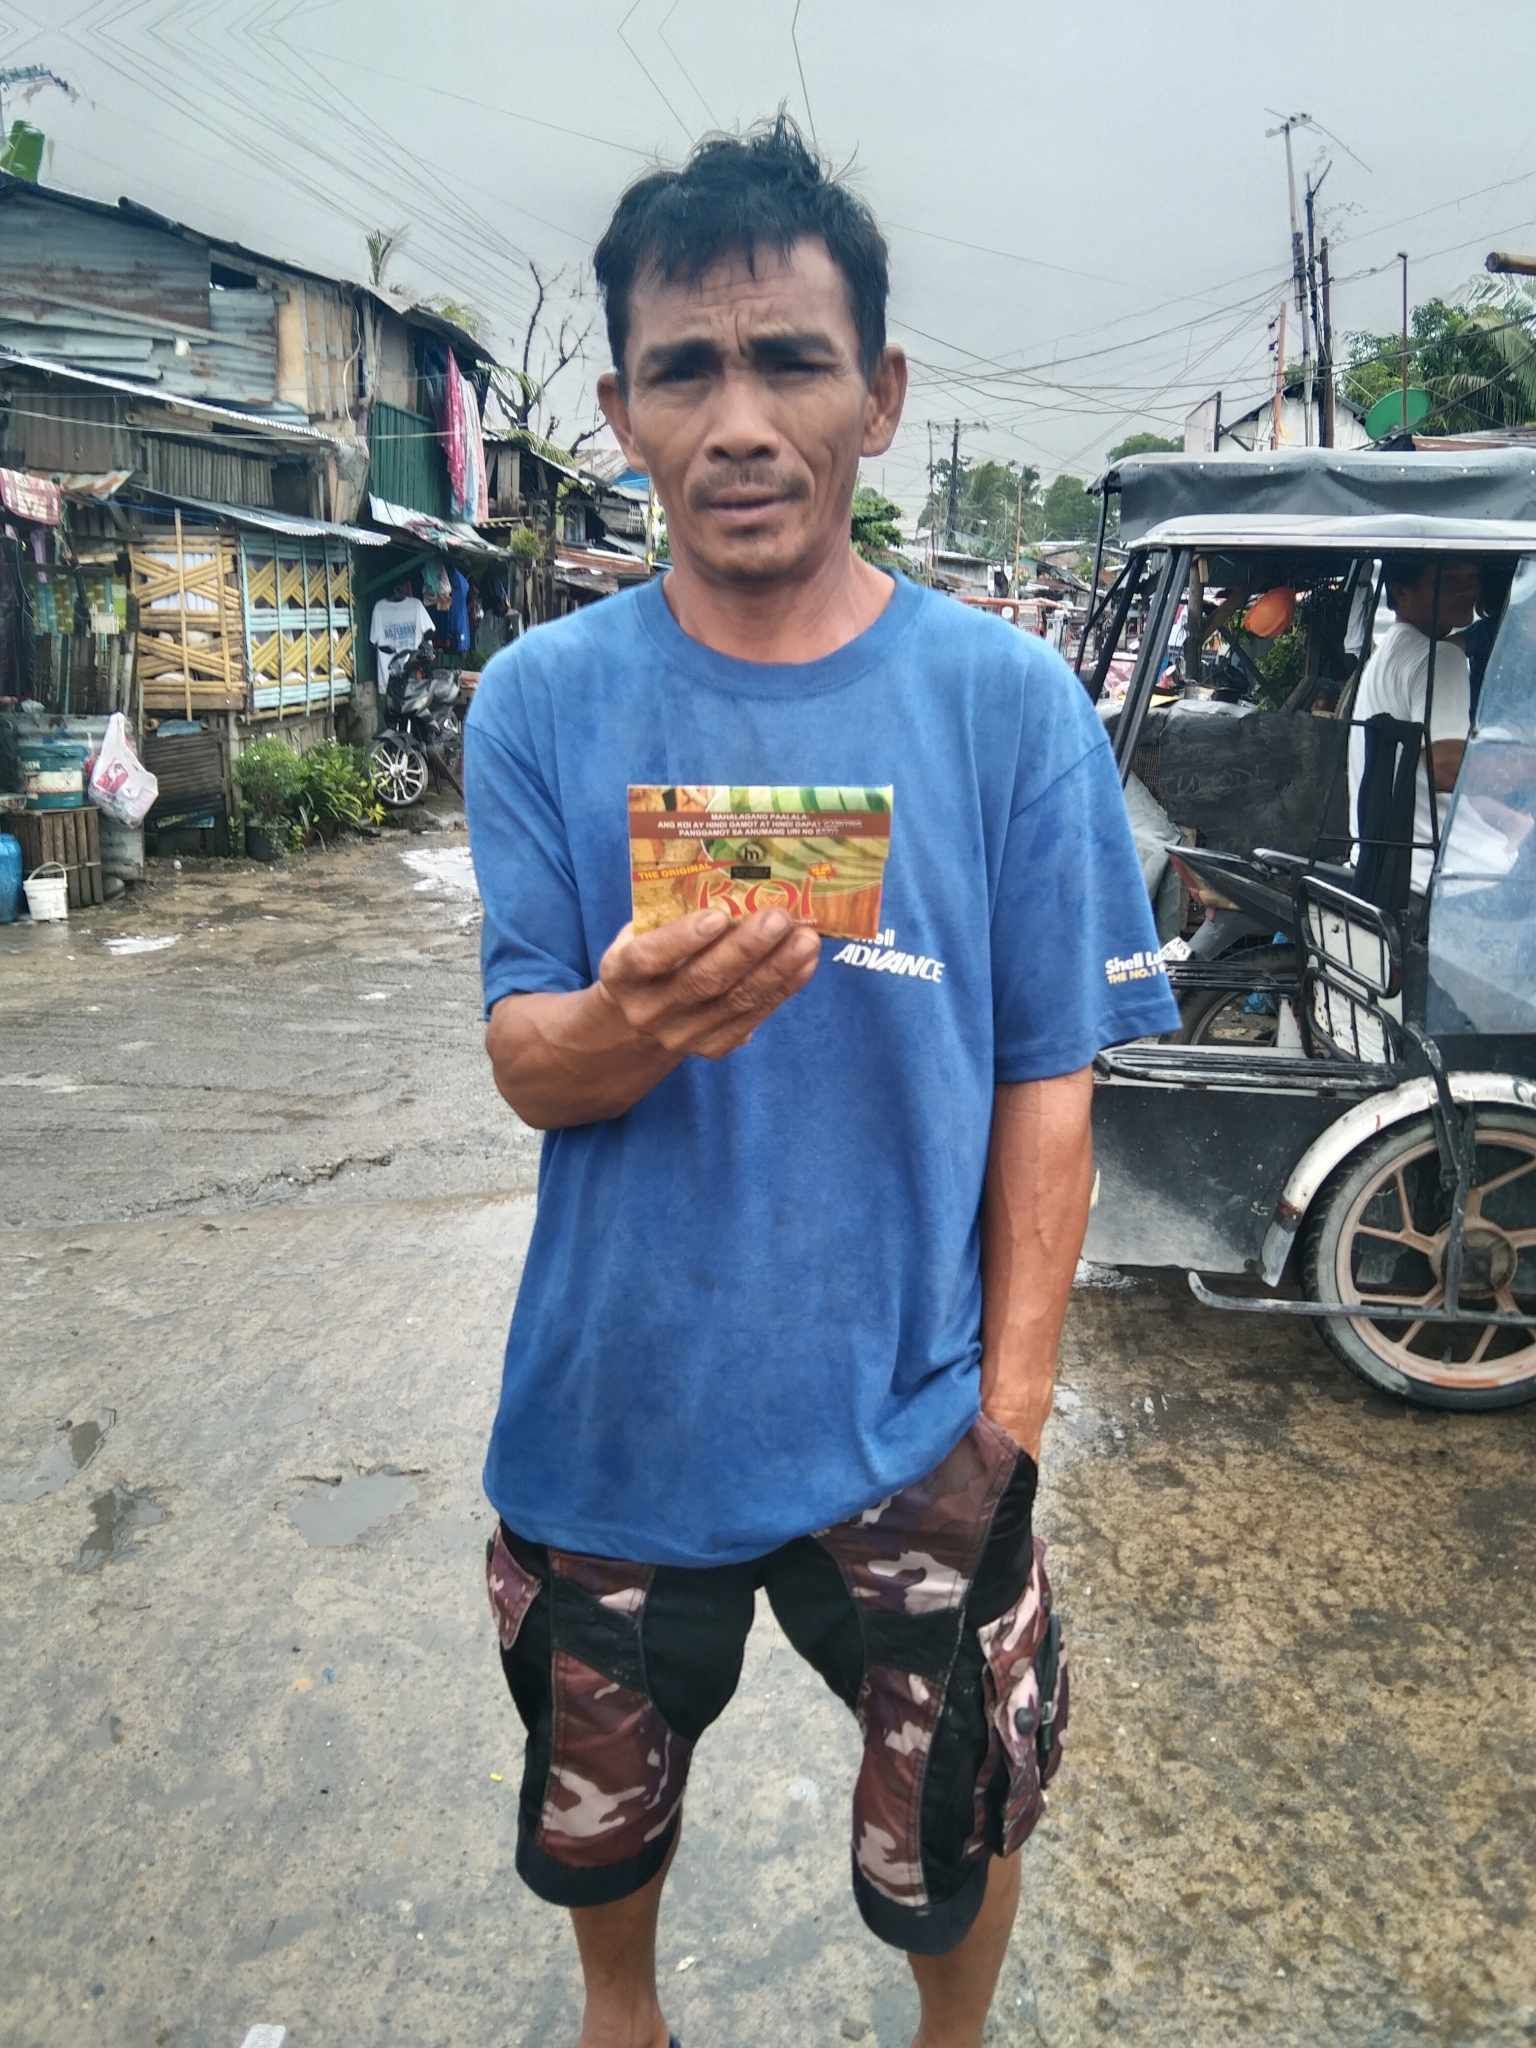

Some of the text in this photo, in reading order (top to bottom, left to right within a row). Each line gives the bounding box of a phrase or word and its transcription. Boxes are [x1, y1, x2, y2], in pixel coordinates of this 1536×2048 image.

[657, 821, 676, 829] ANG
[692, 821, 704, 829] AY
[706, 821, 728, 829] HINDI
[728, 820, 758, 829] GAMOT
[760, 820, 770, 828] AT
[772, 820, 794, 828] HINDI
[732, 828, 743, 836] SA
[744, 828, 785, 836] ANUMANG
[638, 863, 712, 880] THE ORIGINAL
[698, 876, 814, 919] KOI
[832, 943, 947, 984] ADVANCE
[1105, 951, 1144, 975] Shell
[1107, 971, 1127, 985] THE
